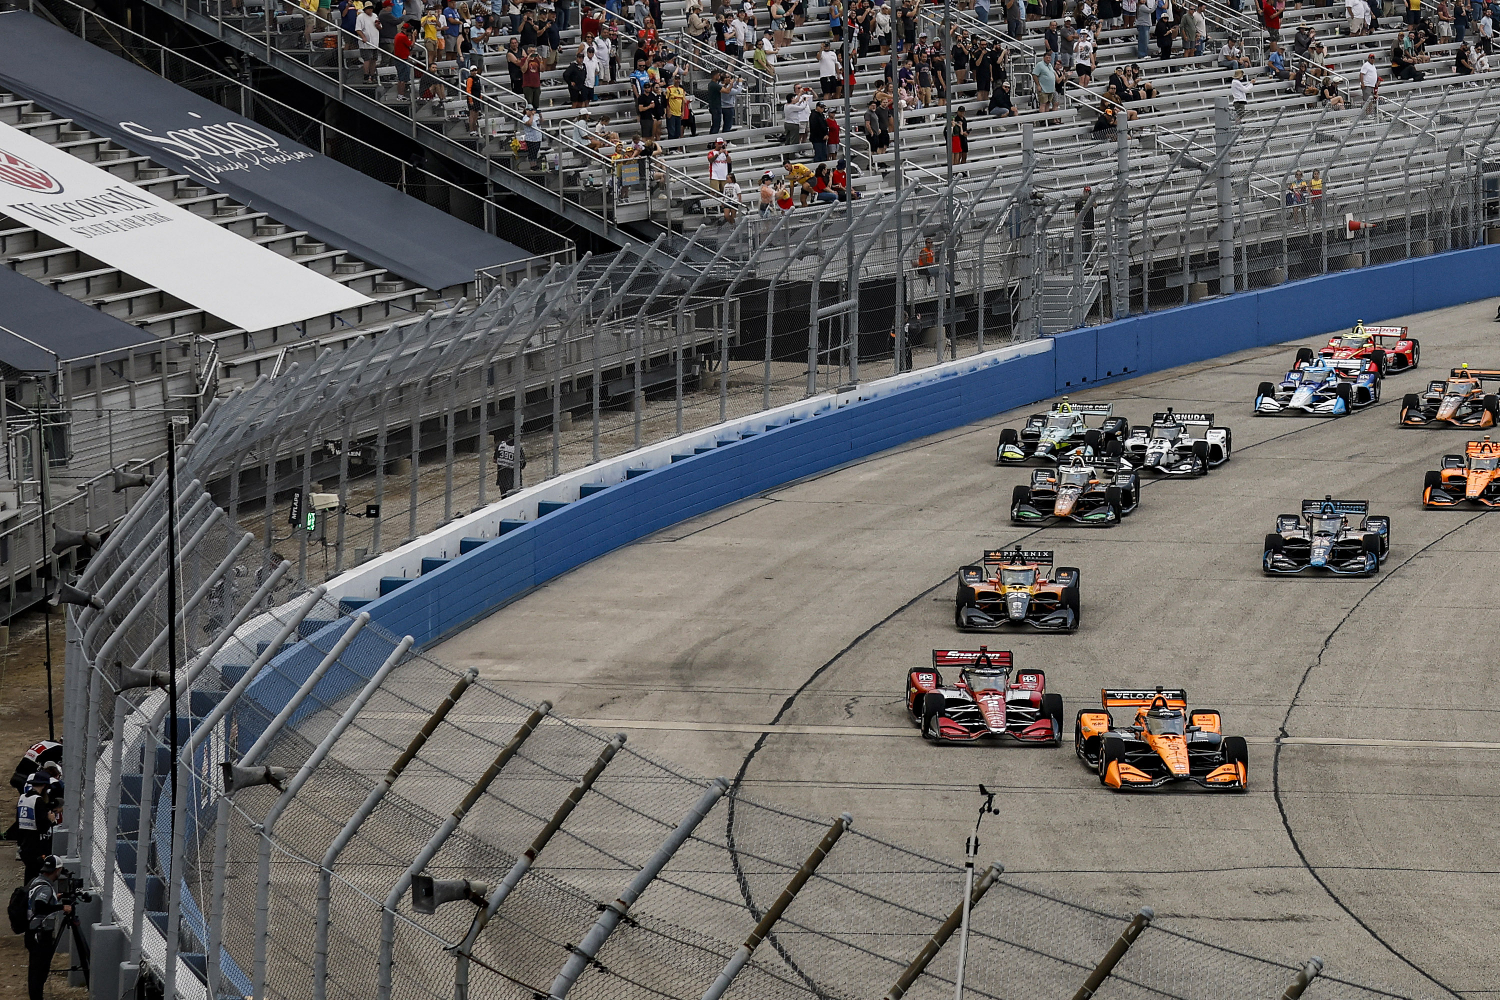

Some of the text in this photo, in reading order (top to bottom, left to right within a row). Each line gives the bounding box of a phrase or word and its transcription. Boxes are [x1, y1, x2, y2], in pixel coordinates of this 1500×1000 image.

[118, 112, 279, 160] Sonsio
[7, 185, 159, 226] WISCONSIN
[70, 212, 174, 238] STATE FAIR PARK
[1114, 692, 1173, 700] VELO.CM
